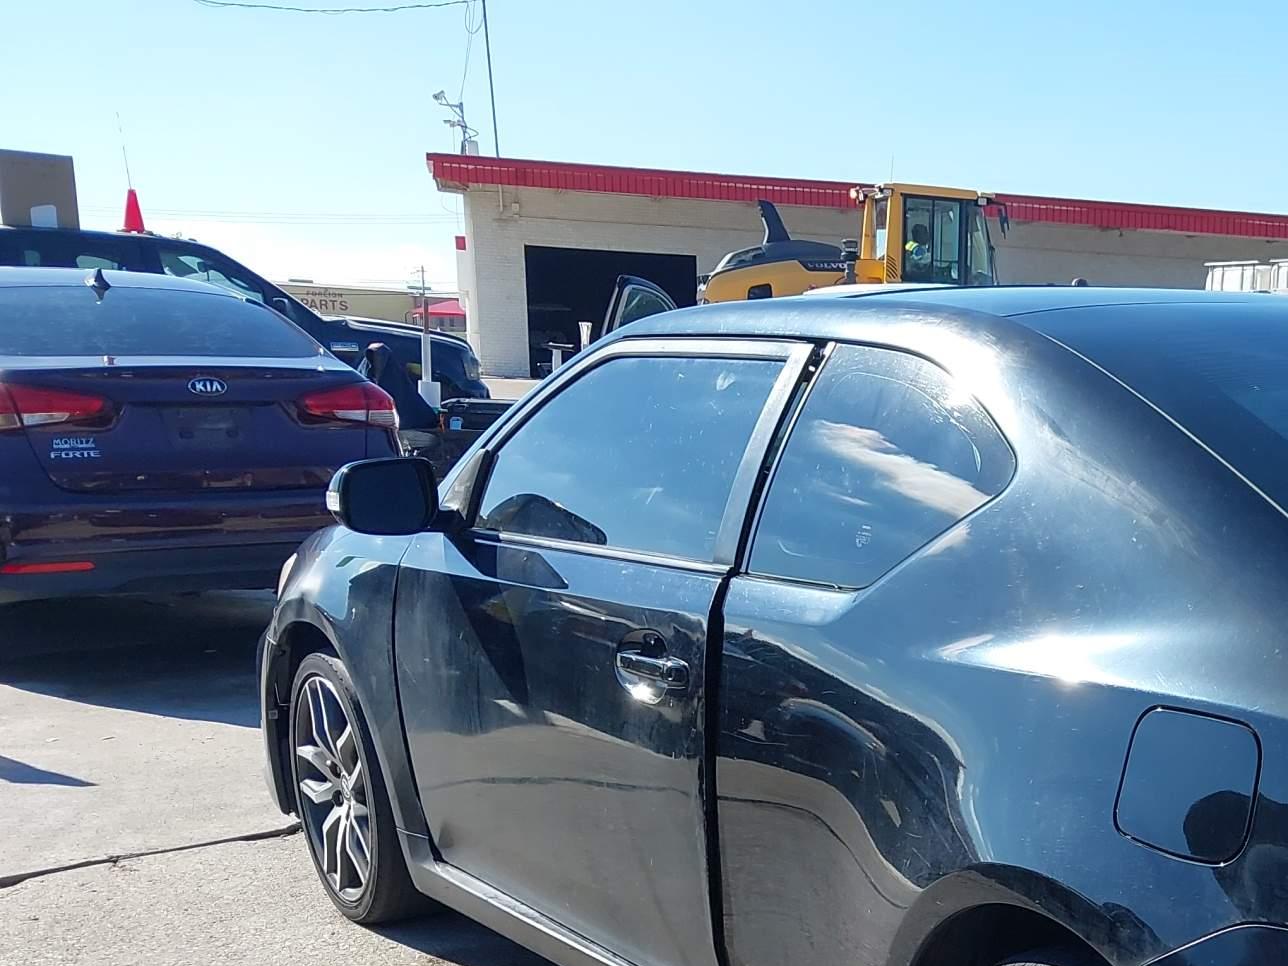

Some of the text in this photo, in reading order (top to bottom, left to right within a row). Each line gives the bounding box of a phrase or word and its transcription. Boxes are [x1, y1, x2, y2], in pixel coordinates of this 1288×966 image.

[301, 297, 349, 312] PARTS
[194, 380, 222, 392] KIA
[50, 450, 102, 459] FORTE
